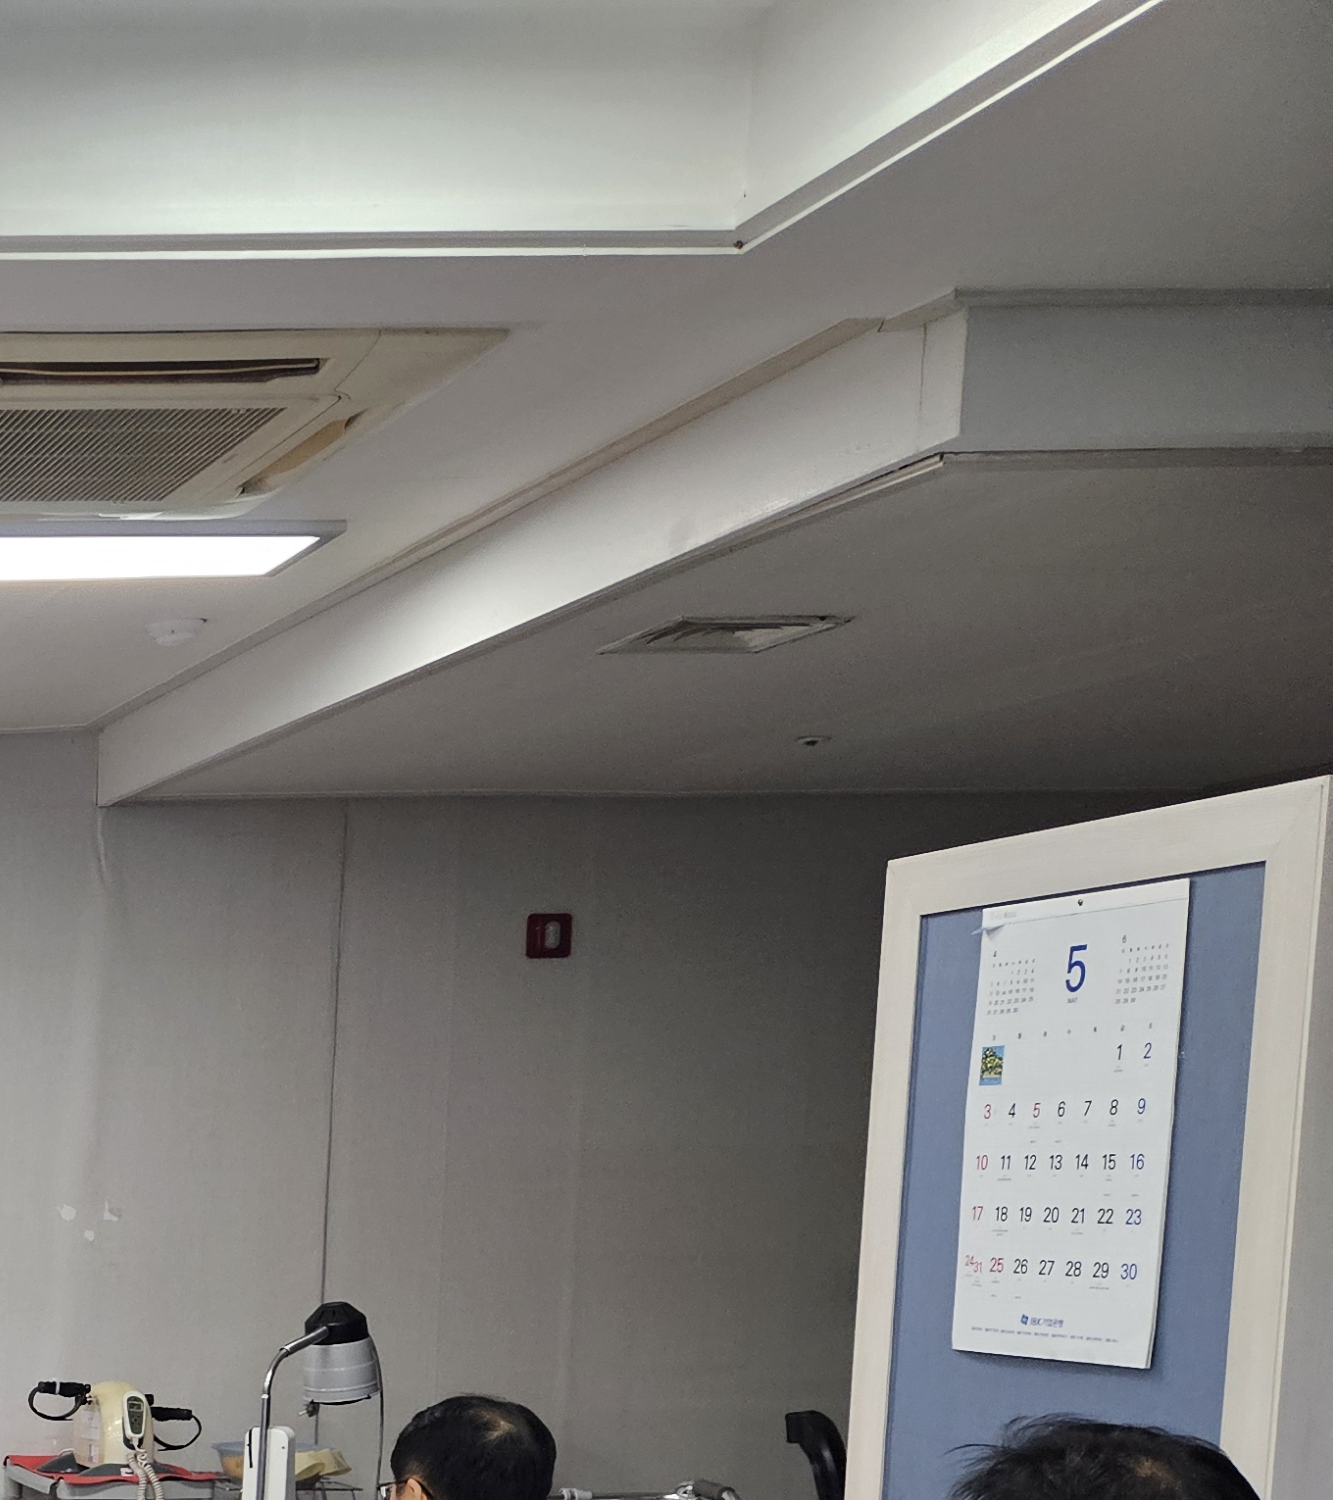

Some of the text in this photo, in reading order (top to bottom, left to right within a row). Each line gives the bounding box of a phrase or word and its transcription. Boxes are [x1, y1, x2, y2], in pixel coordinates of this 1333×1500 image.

[1065, 944, 1088, 992] 5
[1116, 1042, 1152, 1061] 1 2
[983, 1098, 1146, 1119] 3 4 5 6 7 8 9
[976, 1153, 1145, 1171] 10 11 12 13 14 15 16
[972, 1205, 1142, 1226] 17 18 19 20 21 22 23
[965, 1254, 1138, 1280] 24 31 25 26 27 28 29 30
